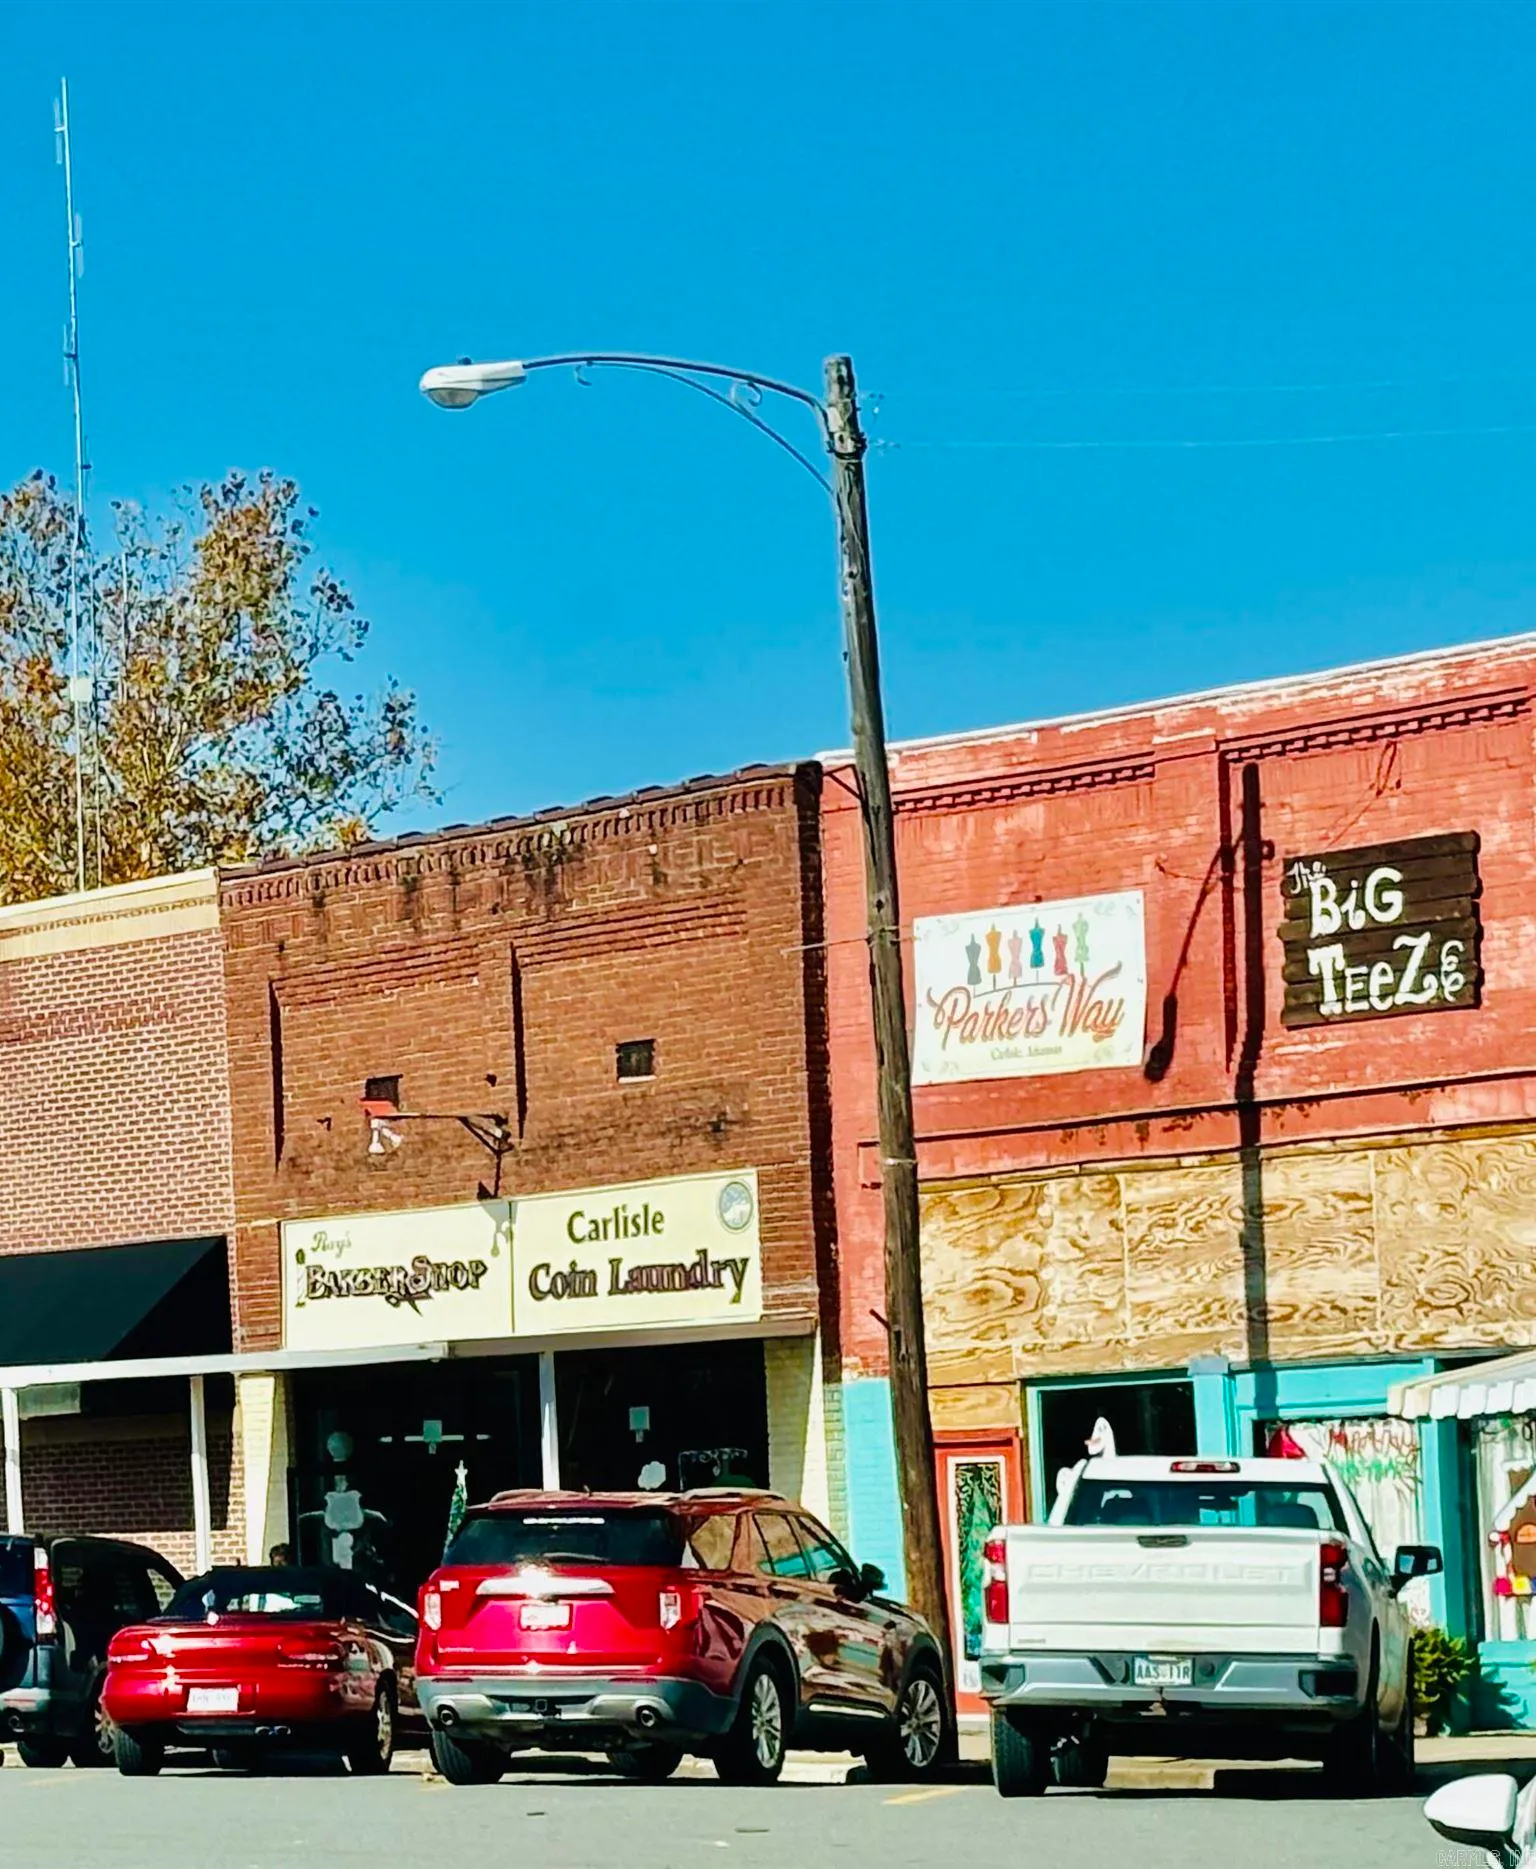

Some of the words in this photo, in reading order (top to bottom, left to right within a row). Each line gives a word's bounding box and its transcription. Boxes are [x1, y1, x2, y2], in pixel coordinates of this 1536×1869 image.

[1051, 960, 1125, 1043] Way
[567, 1203, 665, 1244] Carlisle
[529, 1259, 598, 1301] Coin
[608, 1248, 751, 1304] Laundry
[1028, 1562, 1302, 1583] CHEVROLET
